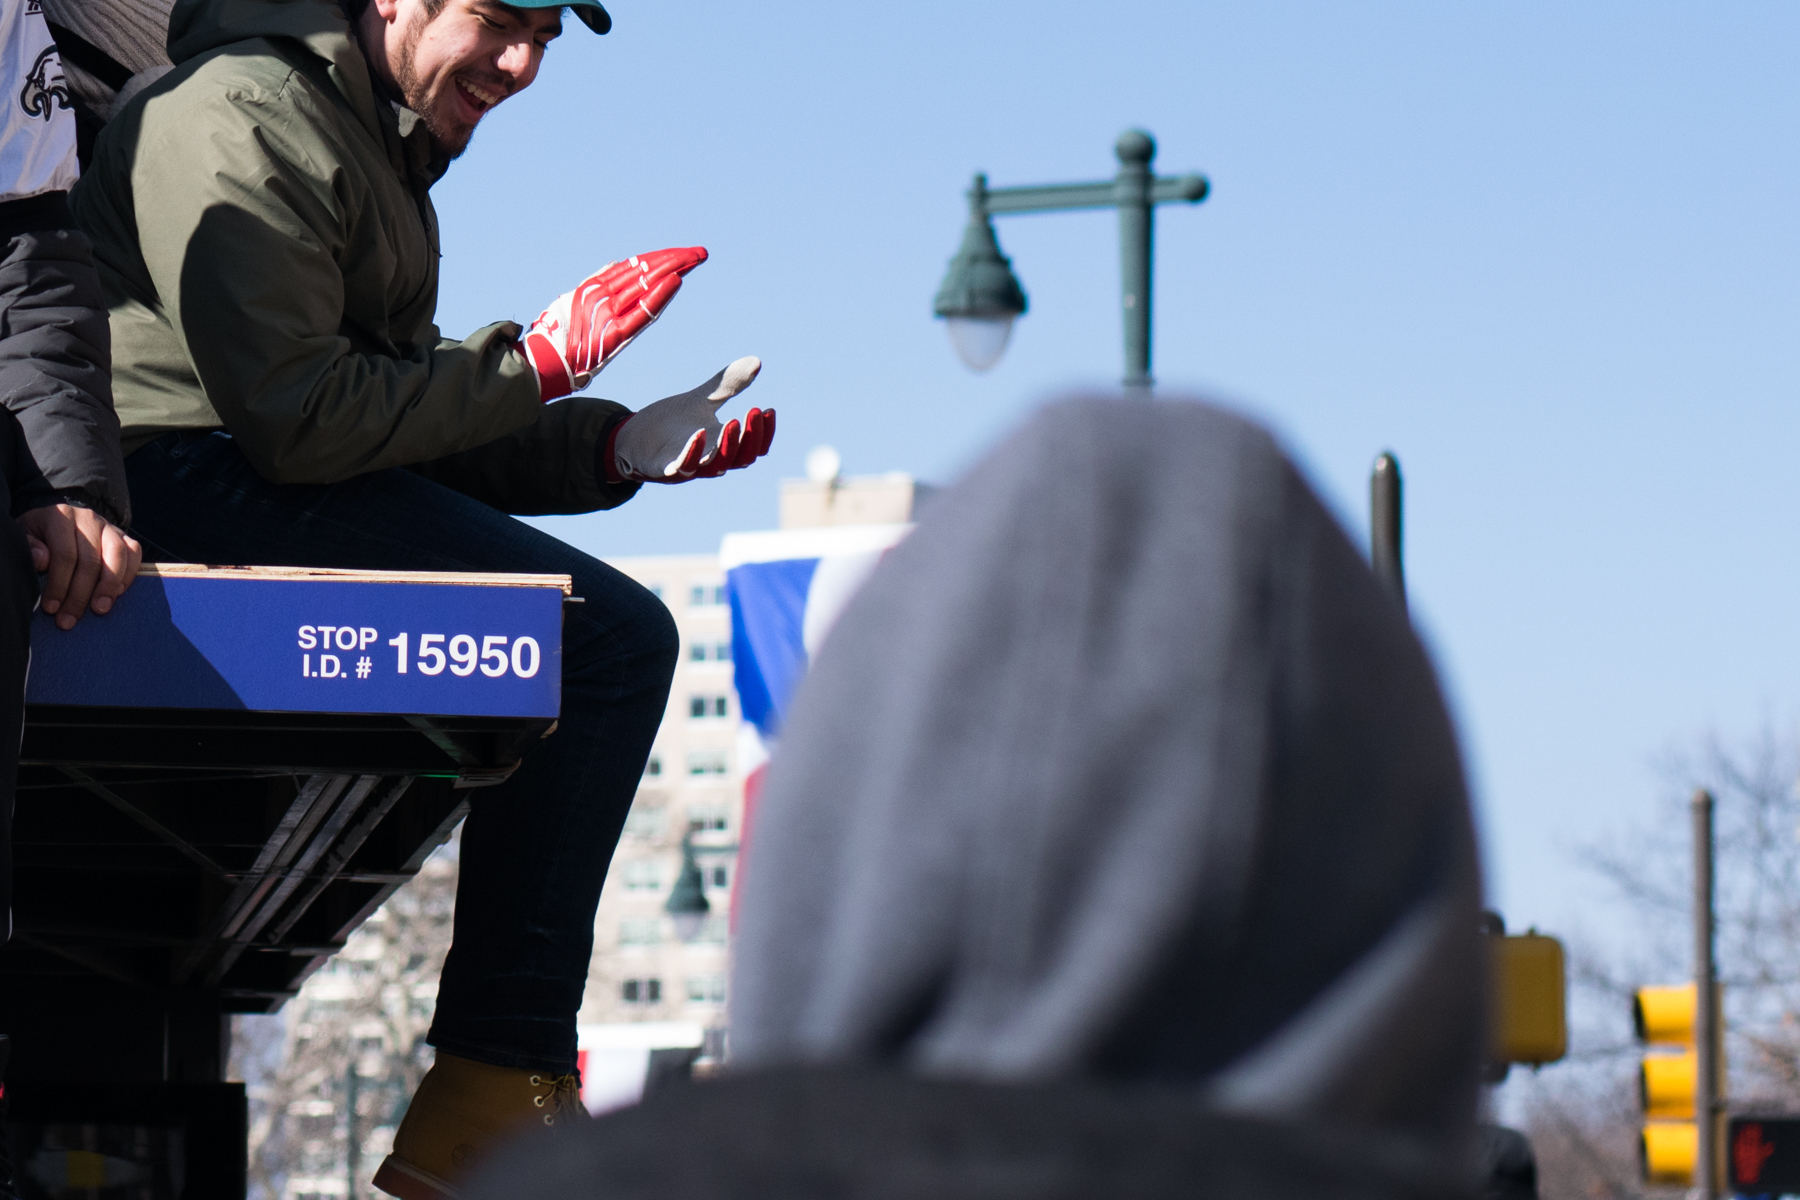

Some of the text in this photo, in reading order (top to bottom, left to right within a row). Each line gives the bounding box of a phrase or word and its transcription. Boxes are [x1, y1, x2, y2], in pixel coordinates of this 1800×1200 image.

[297, 625, 378, 651] STOP
[303, 653, 373, 679] I.D. #
[388, 632, 541, 679] 15950
